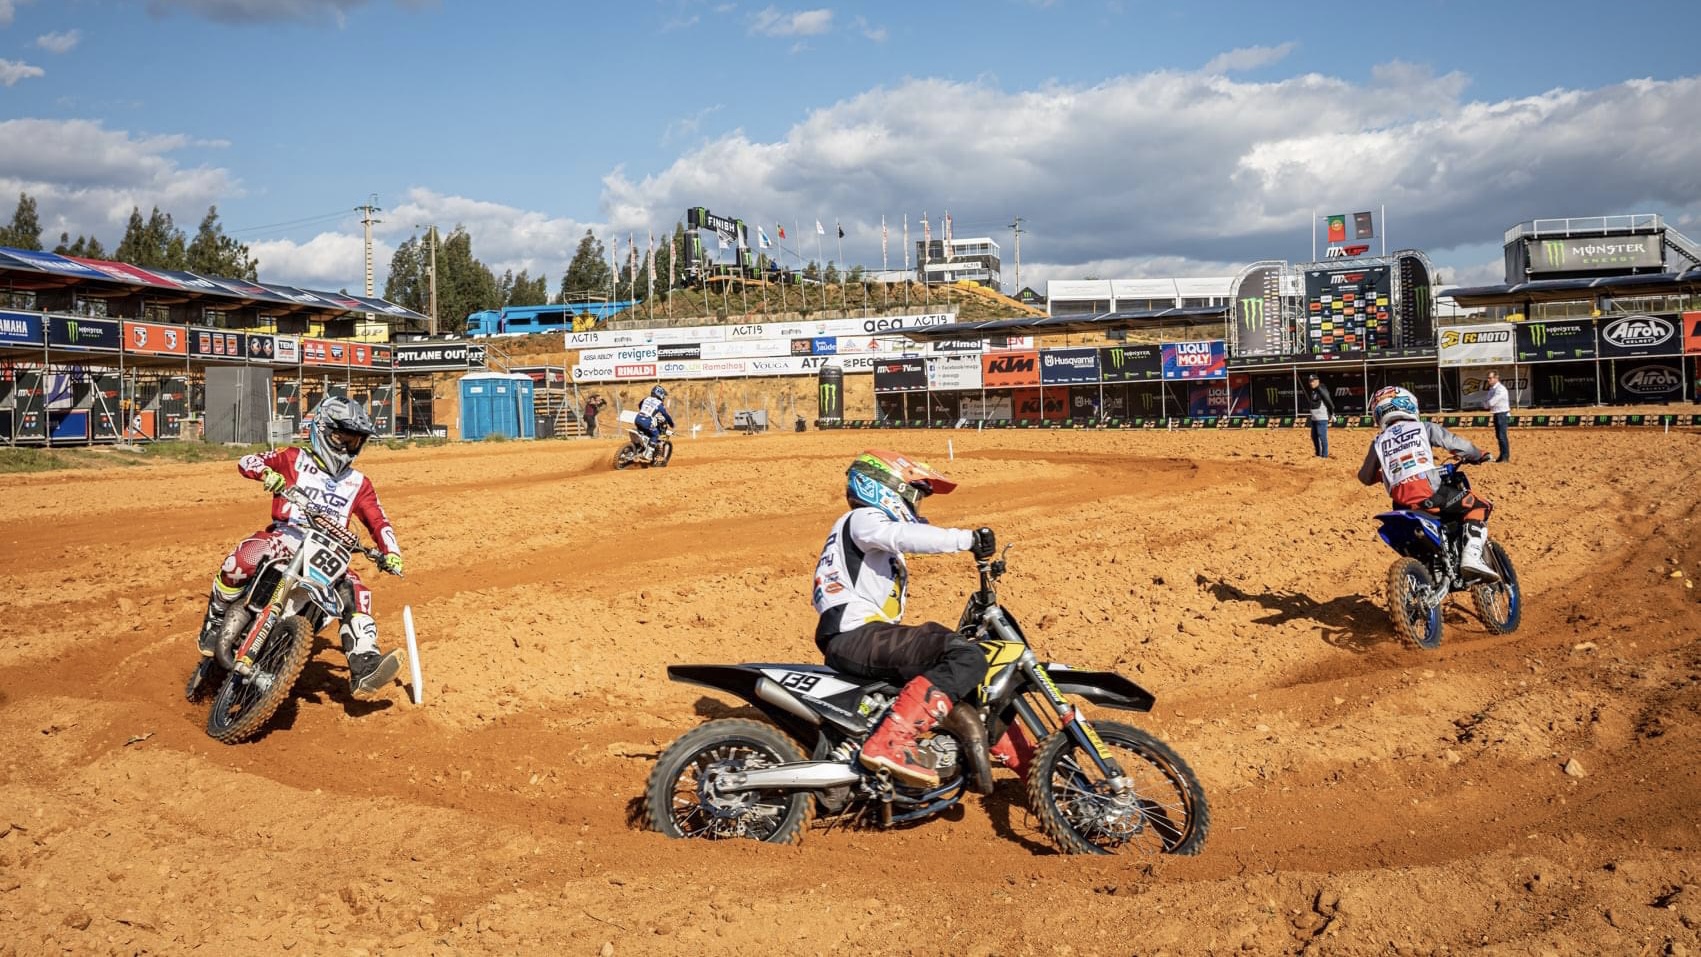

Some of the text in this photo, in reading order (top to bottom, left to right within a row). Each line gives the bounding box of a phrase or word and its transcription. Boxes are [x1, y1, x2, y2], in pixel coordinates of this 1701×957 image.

[708, 217, 735, 232] FINISH
[1573, 243, 1646, 257] MONSTER
[1610, 320, 1666, 339] Airoh
[398, 349, 466, 362] PITLANE OUT
[1177, 343, 1209, 354] LIQUI
[988, 356, 1034, 373] KTM
[1055, 356, 1094, 366] Husqvarna
[1178, 353, 1210, 365] MOLY
[617, 366, 654, 376] RINALDI
[1382, 428, 1421, 450] MXGP
[1384, 440, 1421, 457] Academy
[309, 548, 343, 578] 69
[780, 671, 822, 693] 139
